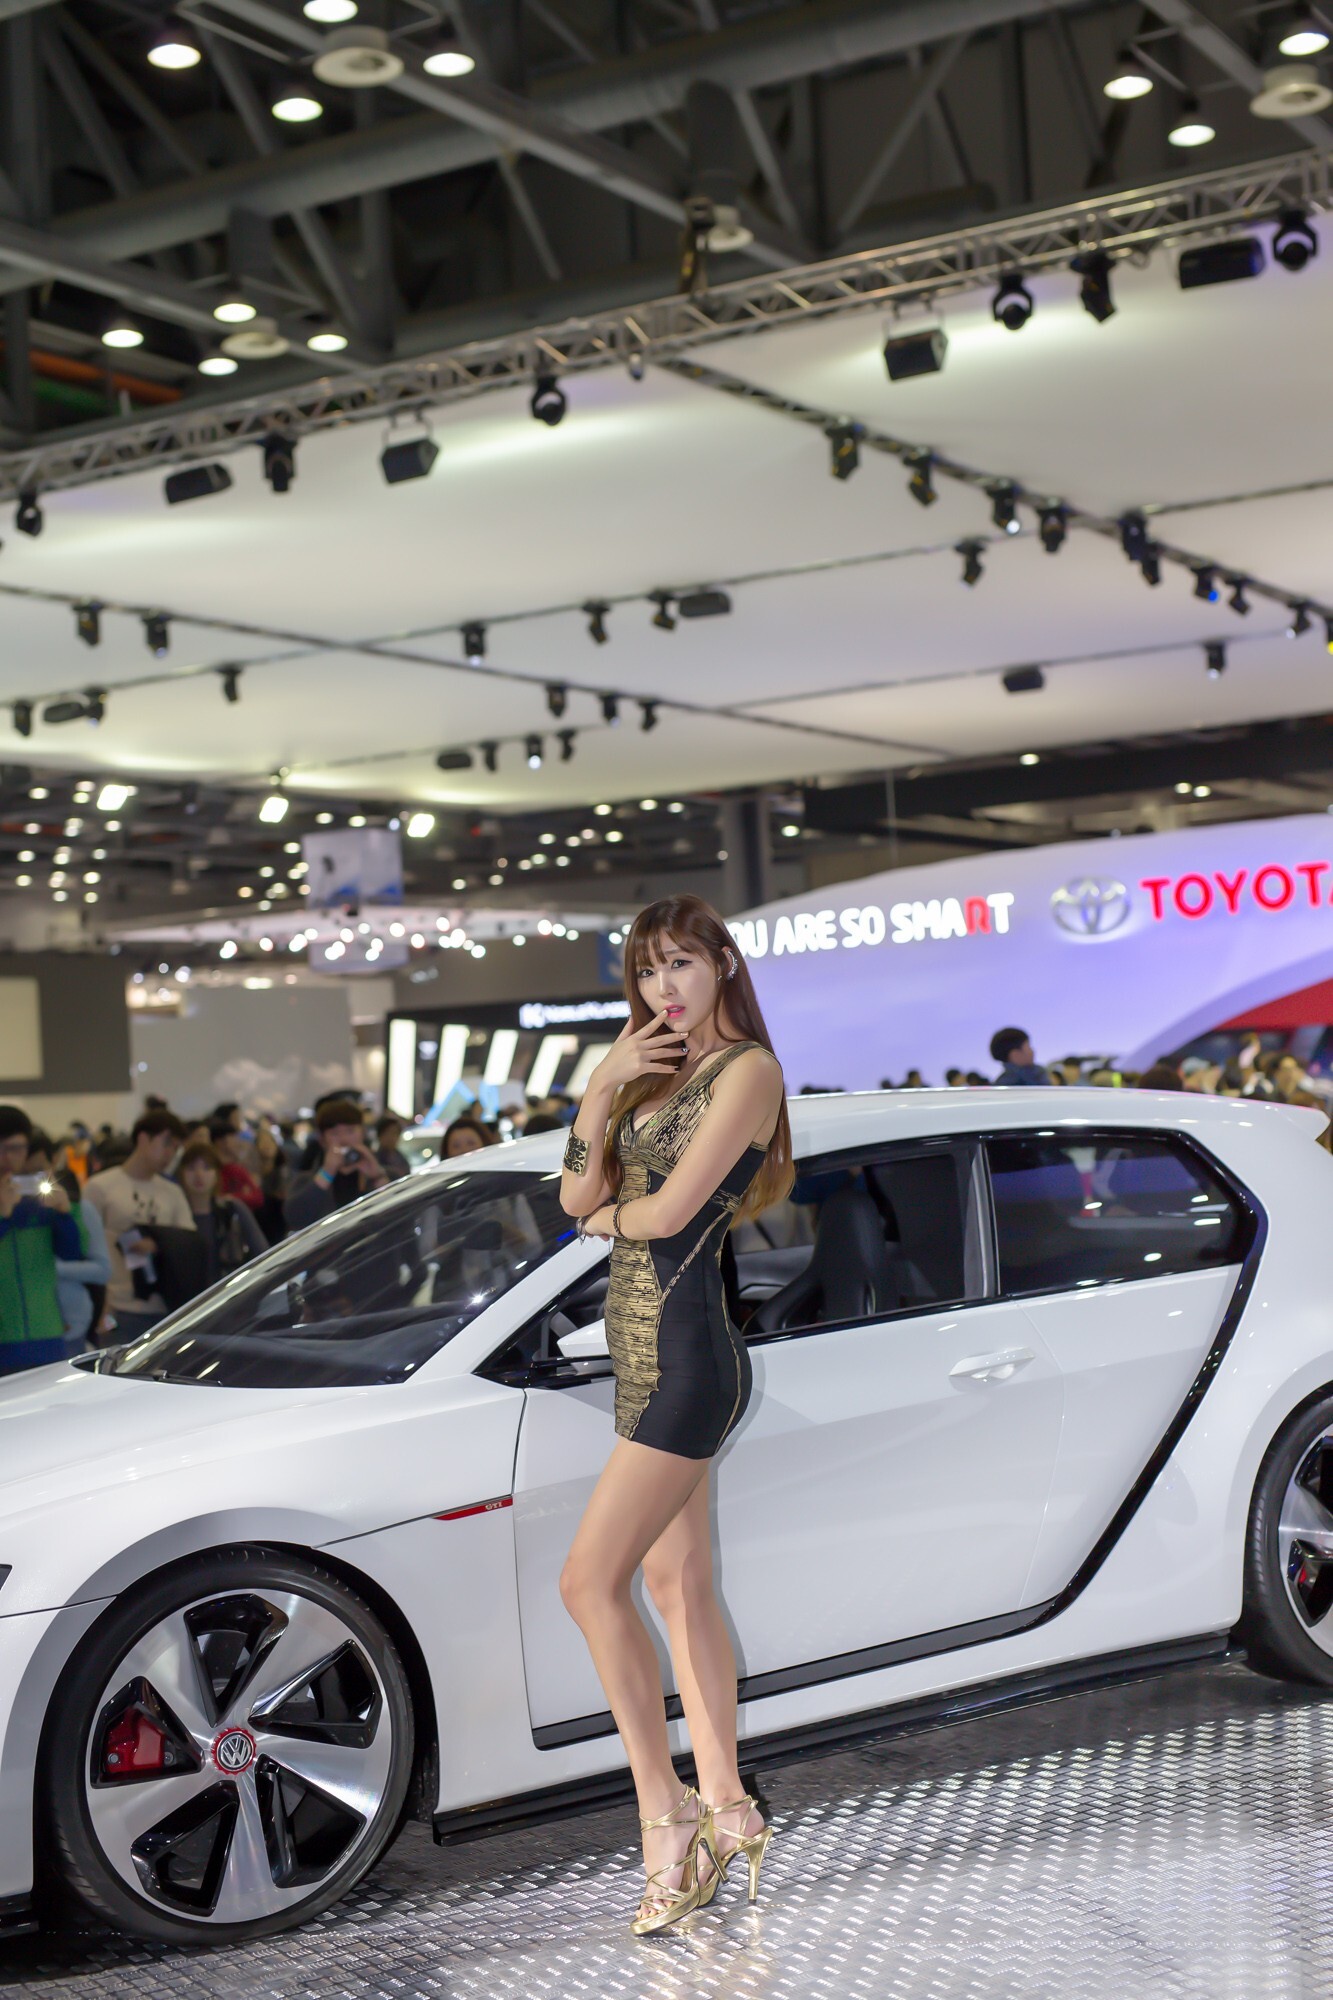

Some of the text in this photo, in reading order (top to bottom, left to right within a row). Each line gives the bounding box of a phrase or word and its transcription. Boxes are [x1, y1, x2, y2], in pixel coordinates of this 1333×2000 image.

[1138, 860, 1333, 921] TOYOT
[724, 892, 1015, 958] OU ARE SO SMART
[485, 1501, 502, 1511] GTI
